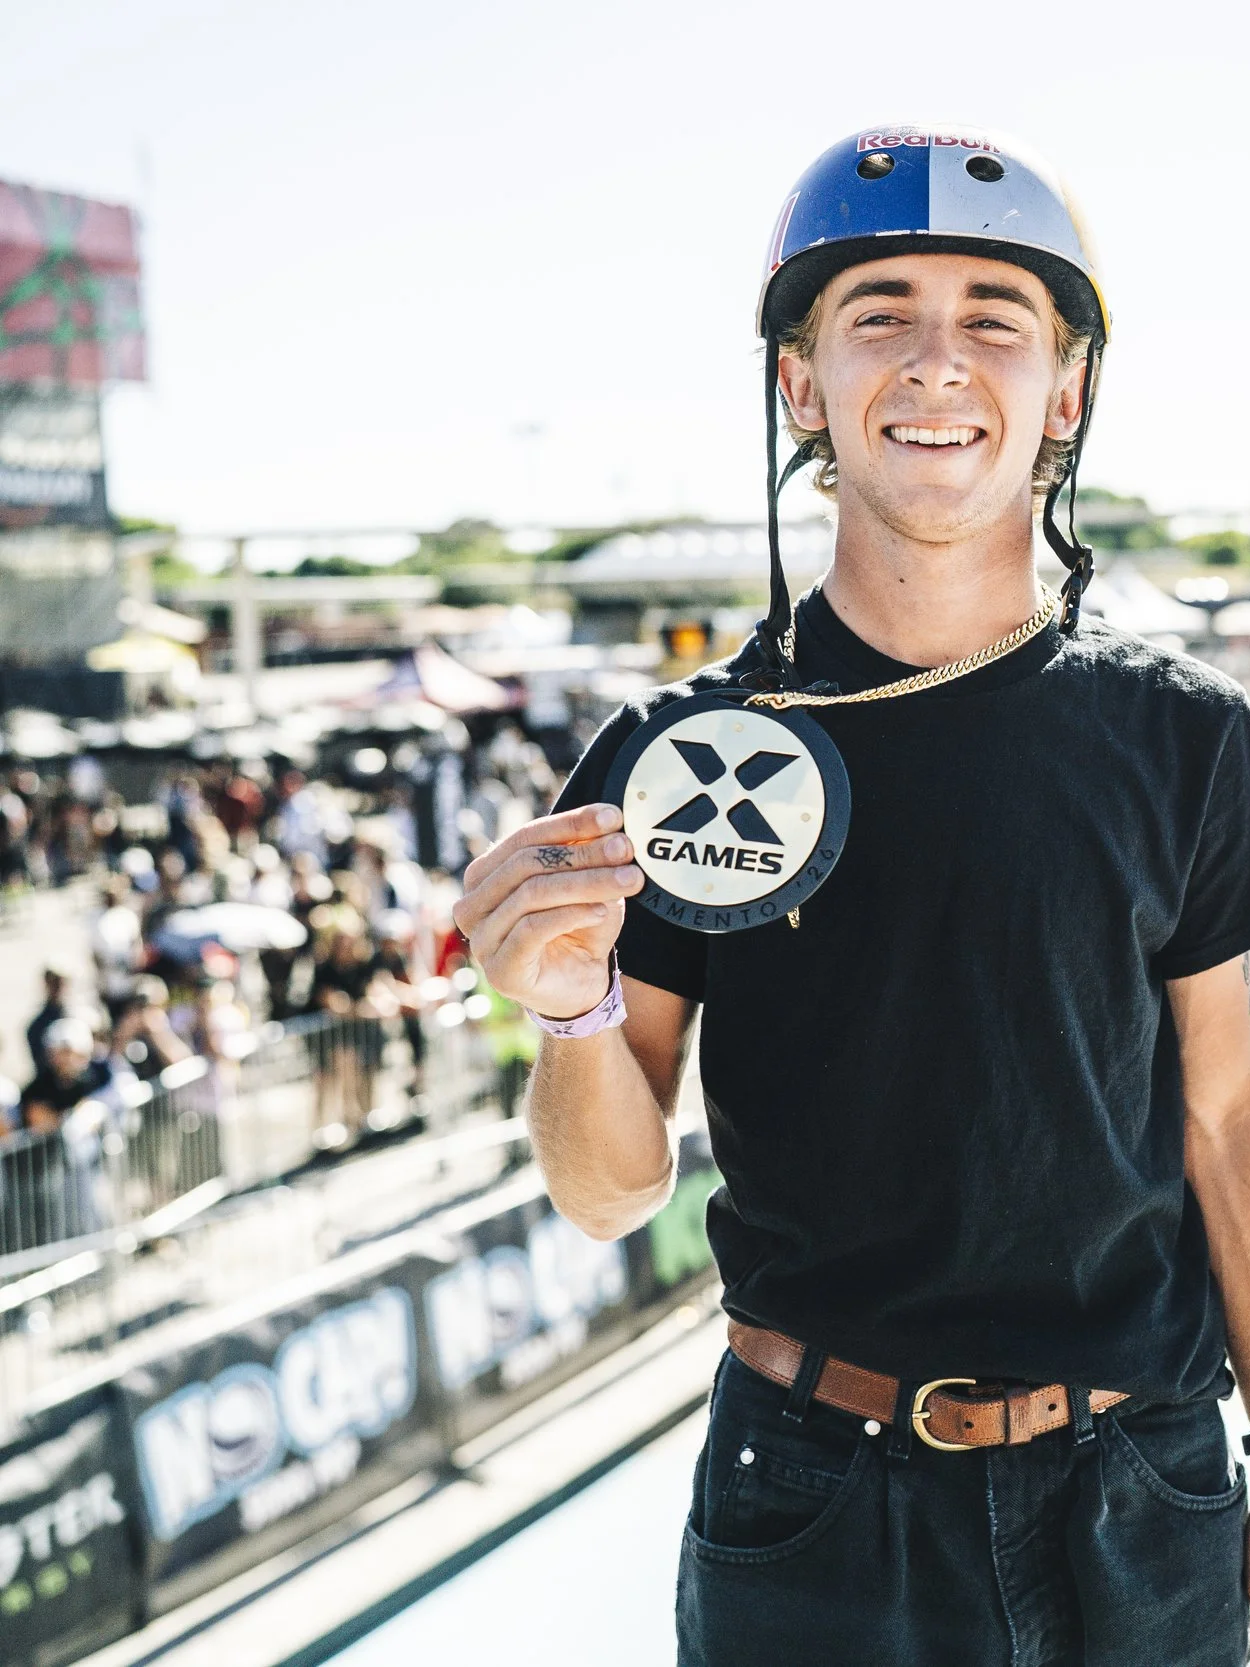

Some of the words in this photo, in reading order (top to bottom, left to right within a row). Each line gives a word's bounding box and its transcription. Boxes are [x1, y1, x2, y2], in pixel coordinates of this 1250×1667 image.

[650, 737, 802, 847] X
[646, 836, 785, 876] GAMES
[646, 892, 778, 928] AMENTO
